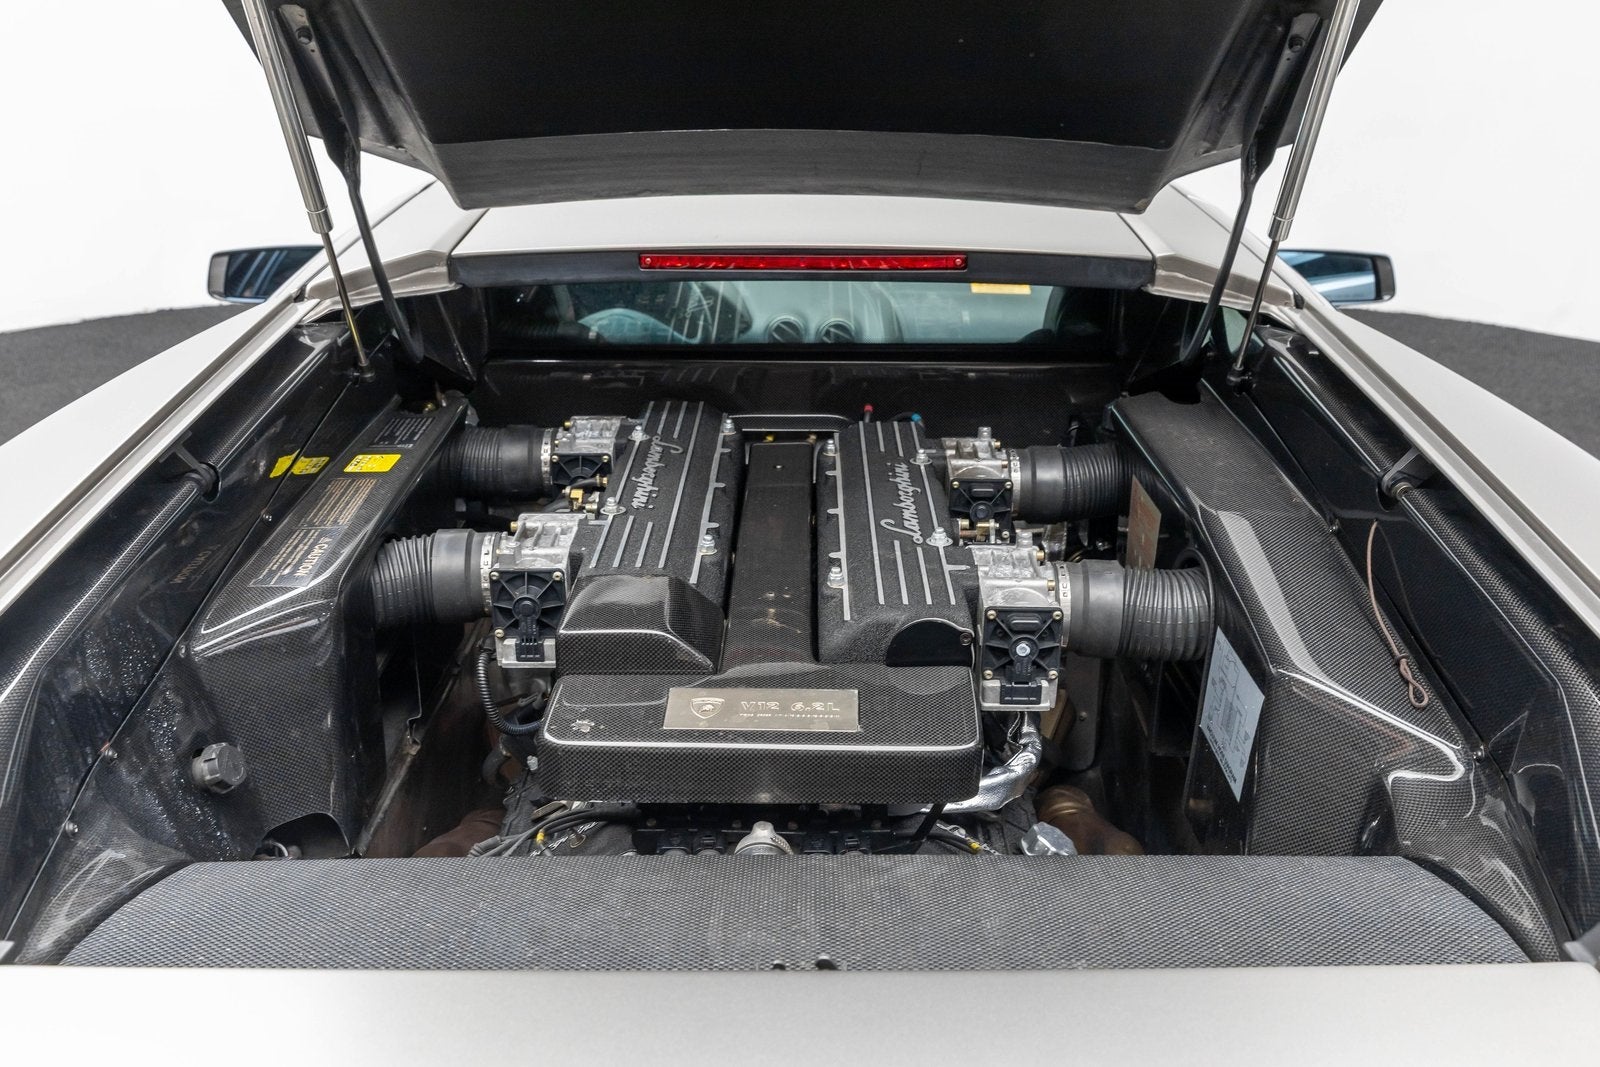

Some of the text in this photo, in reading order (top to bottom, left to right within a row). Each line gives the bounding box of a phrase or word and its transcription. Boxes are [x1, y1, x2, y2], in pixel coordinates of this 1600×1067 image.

[631, 434, 683, 509] Lamborghini
[880, 462, 923, 544] Lamborghini
[293, 544, 328, 576] CAUTION
[740, 701, 840, 712] V12 6.2L
